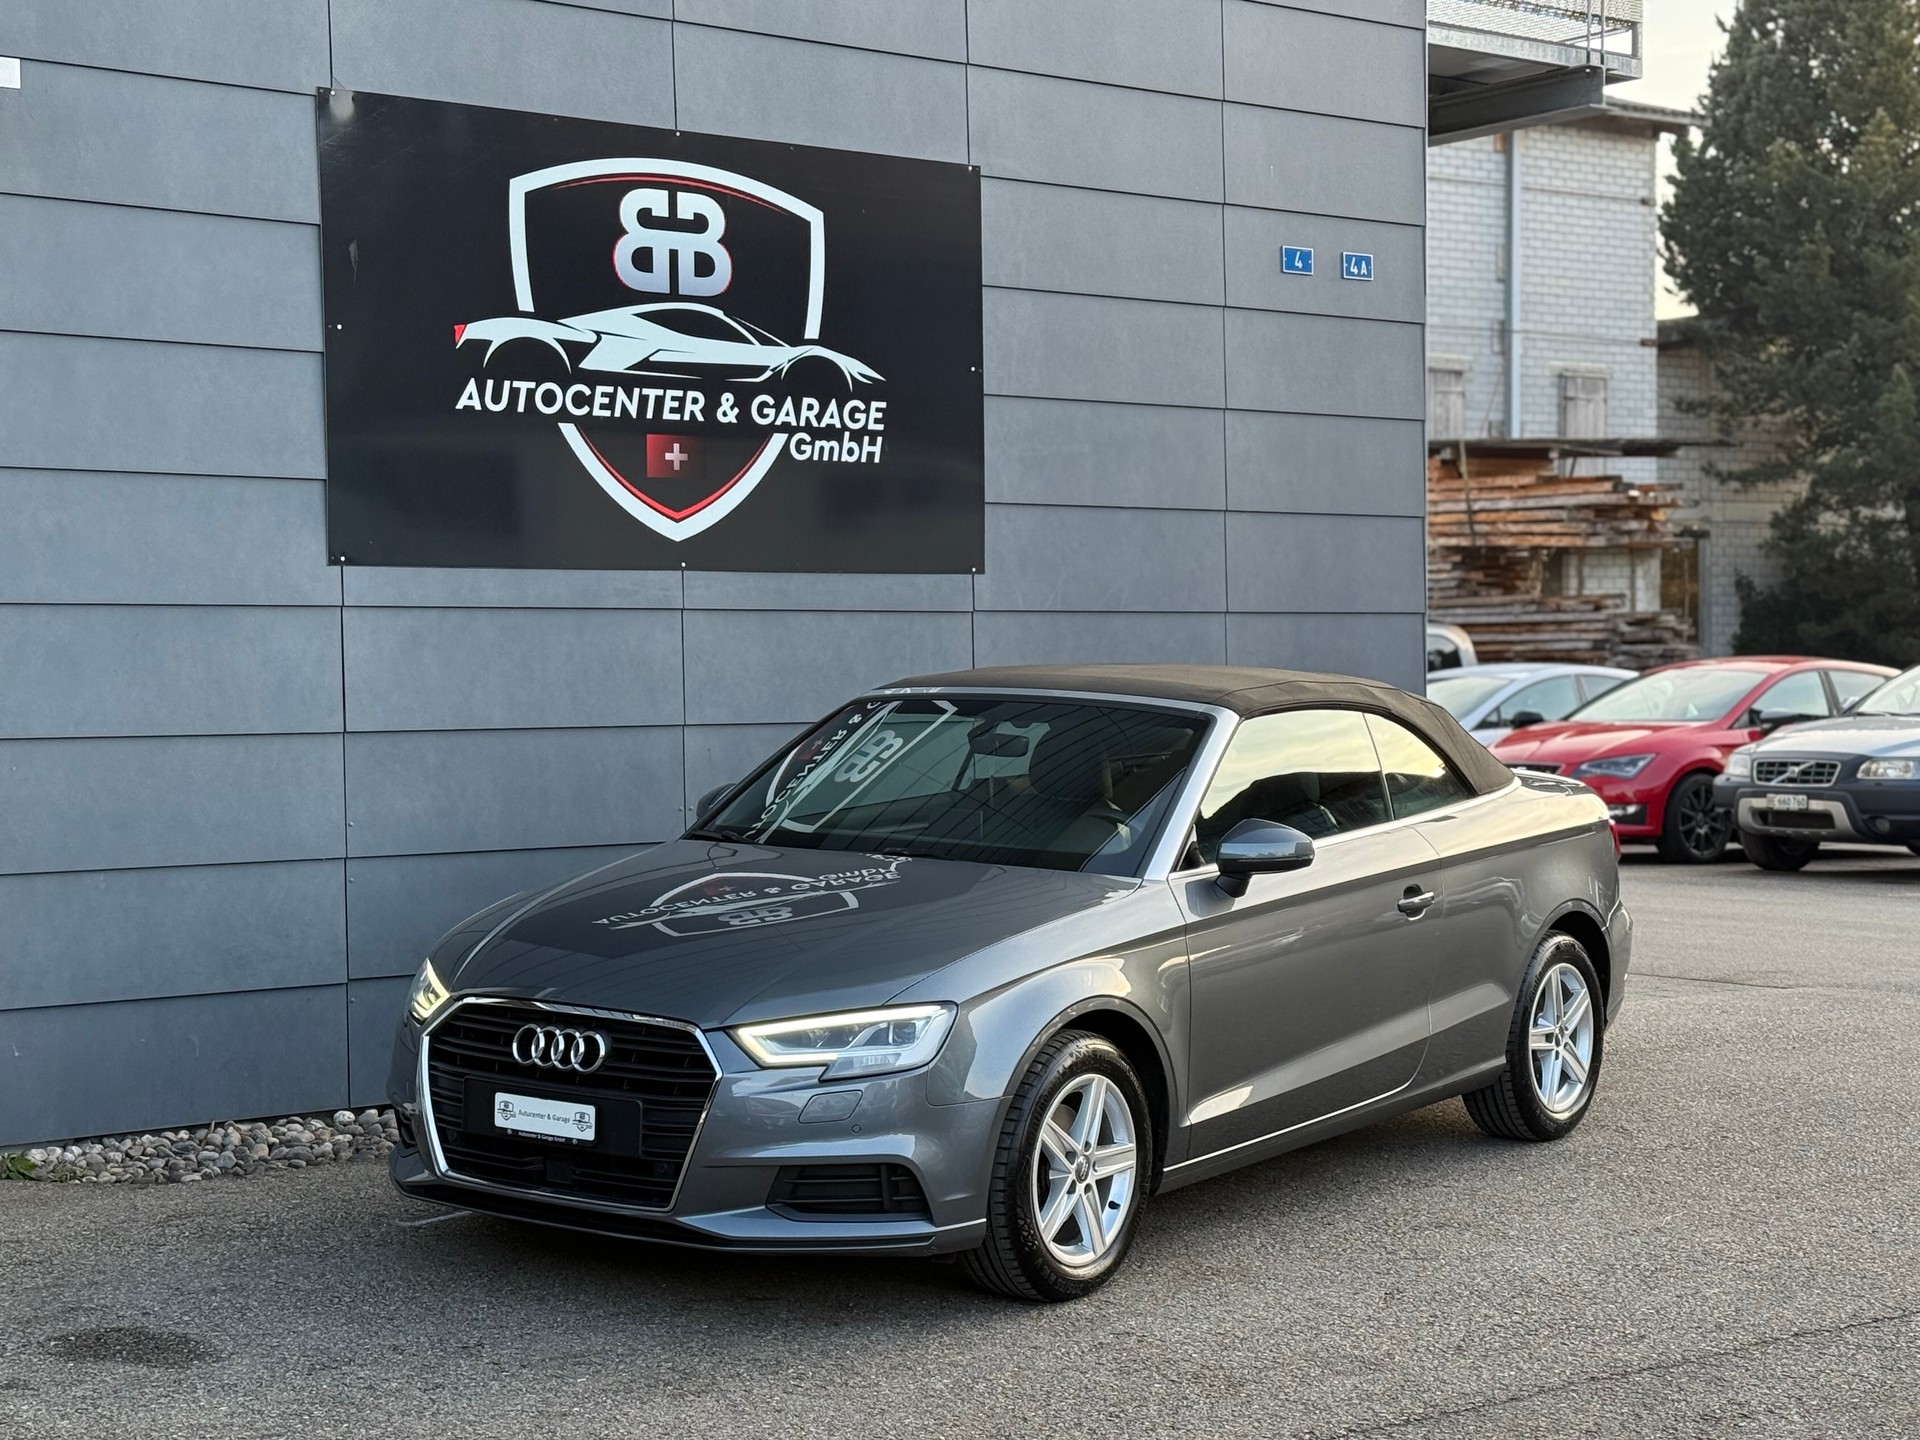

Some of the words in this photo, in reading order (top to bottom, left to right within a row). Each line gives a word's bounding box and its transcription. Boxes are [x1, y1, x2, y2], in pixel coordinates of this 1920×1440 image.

[1294, 250, 1303, 269] 4
[1350, 256, 1368, 276] 4A
[455, 377, 706, 422] AUTOCENTER
[716, 392, 740, 424] &
[751, 394, 887, 431] GARAGE
[789, 431, 883, 464] GmbH
[518, 1109, 546, 1119] Autocenter
[552, 1114, 571, 1124] Garage
